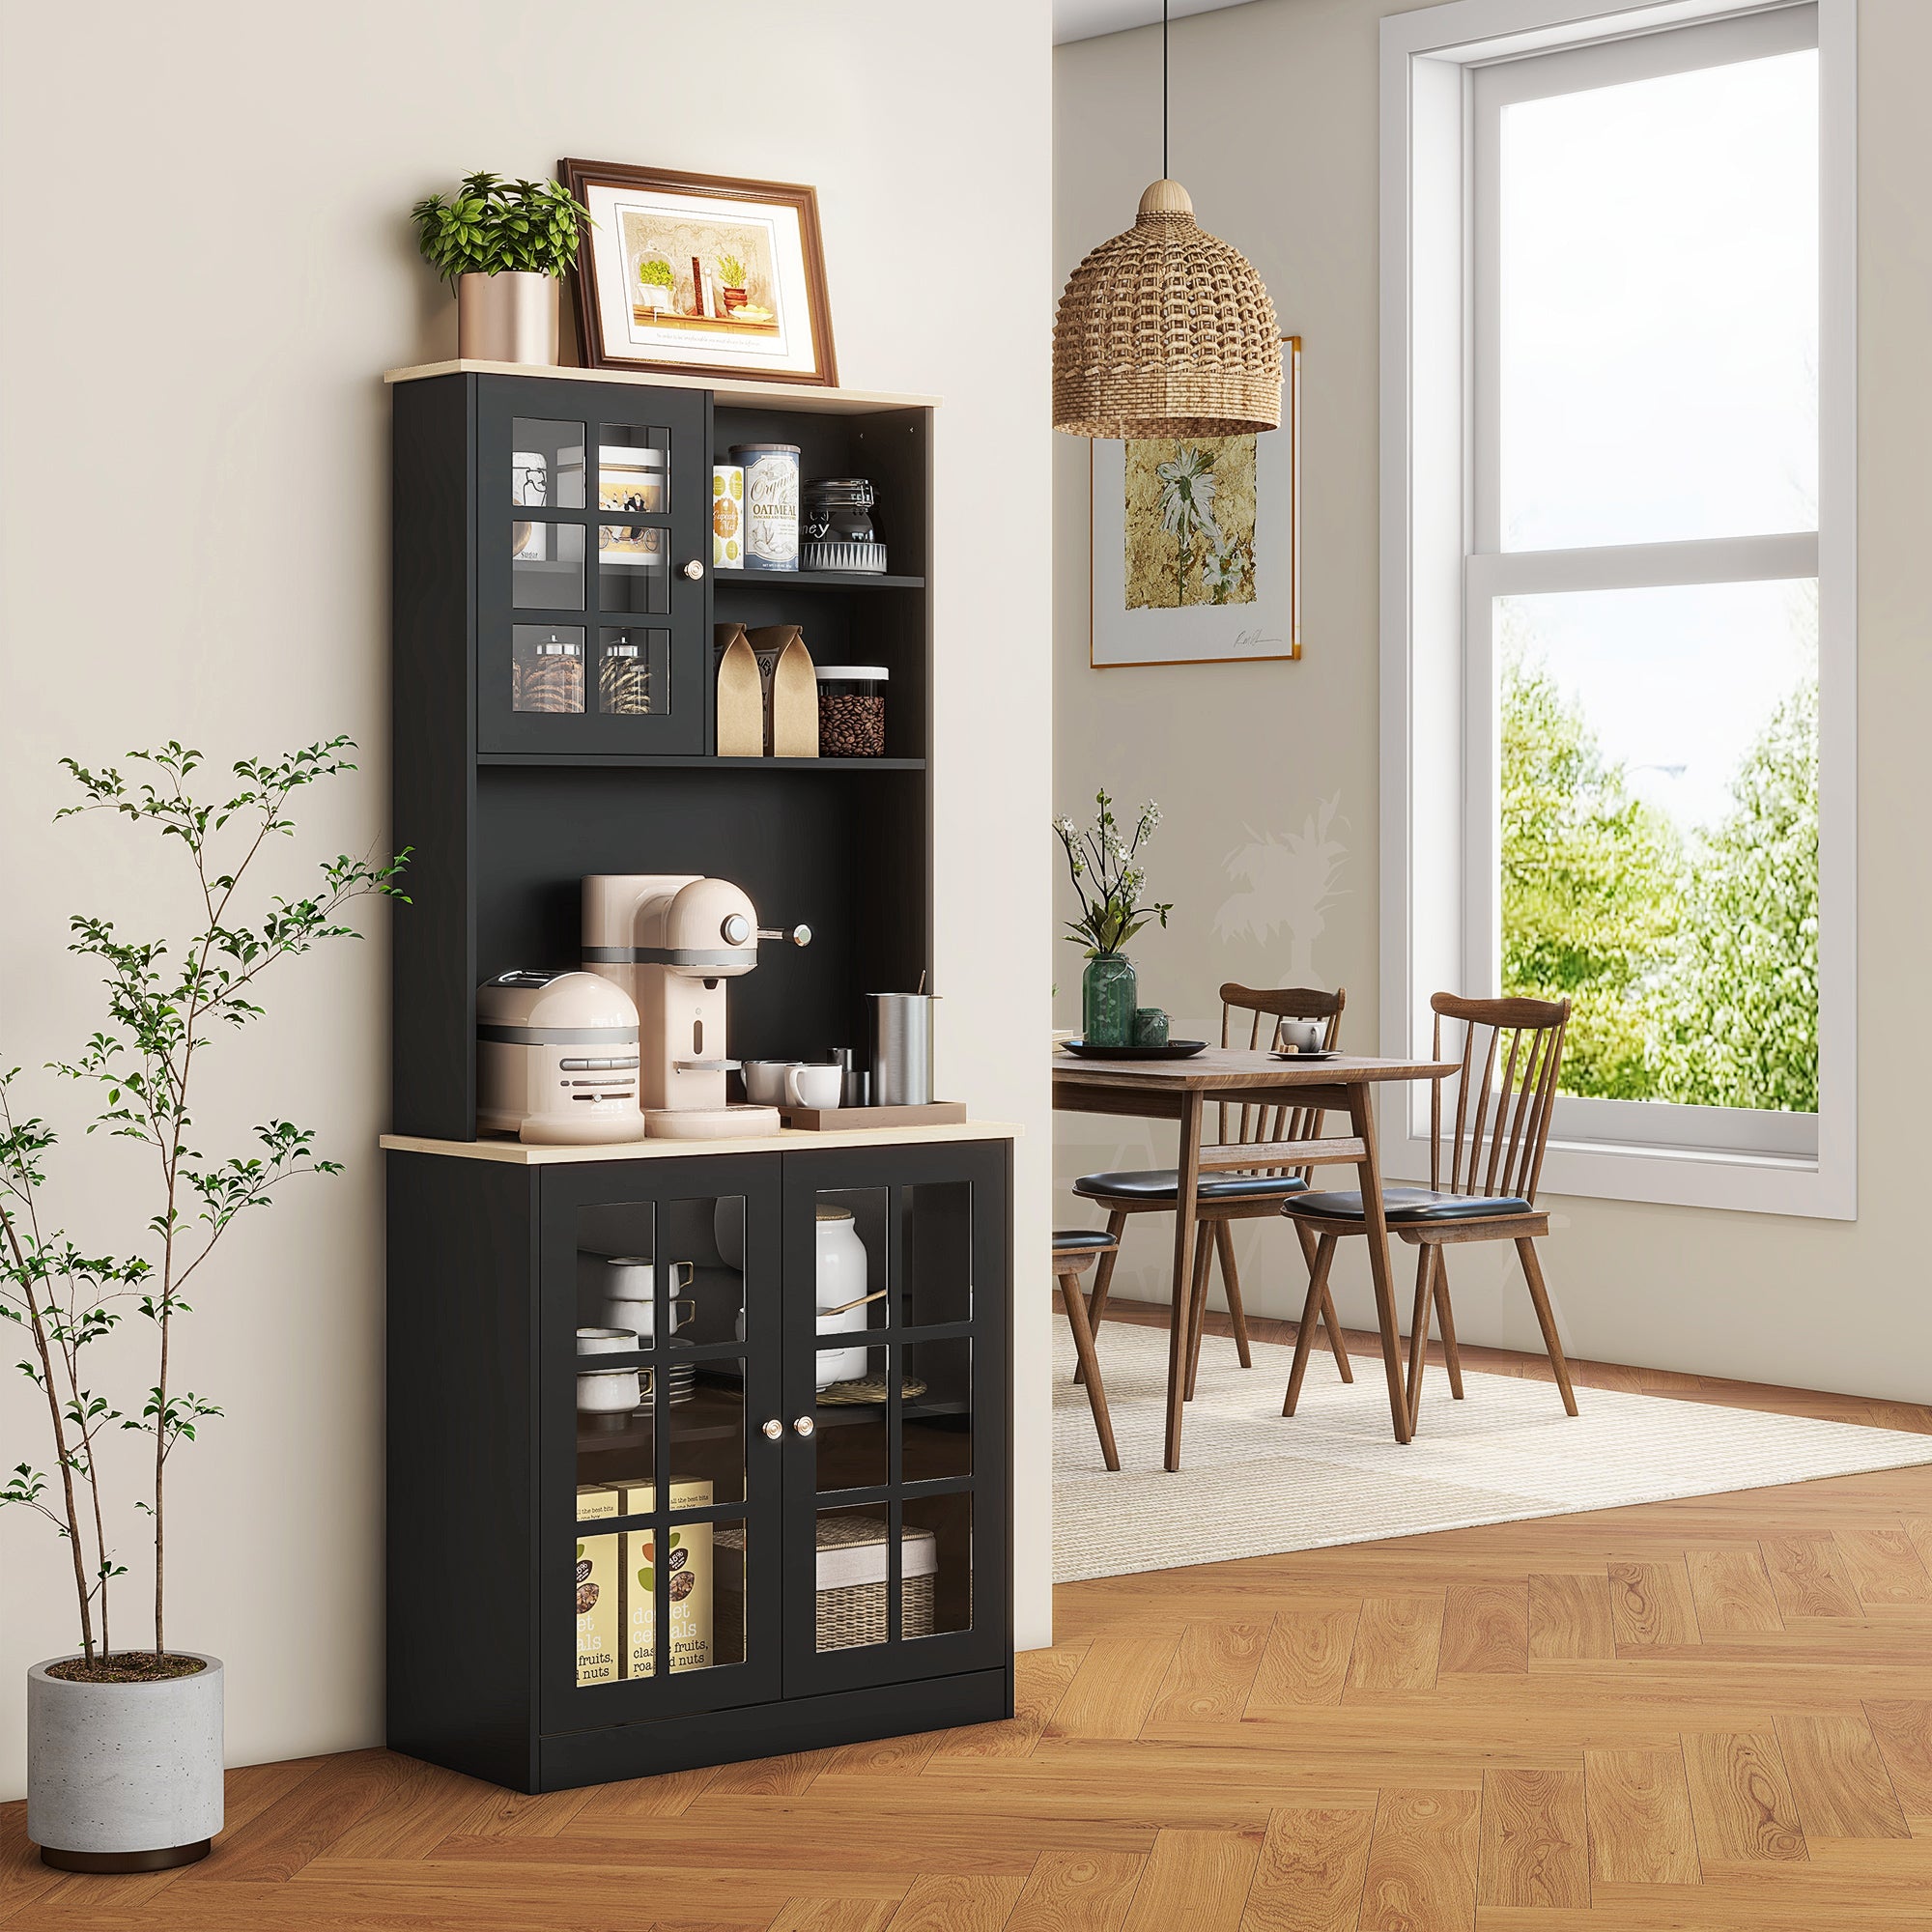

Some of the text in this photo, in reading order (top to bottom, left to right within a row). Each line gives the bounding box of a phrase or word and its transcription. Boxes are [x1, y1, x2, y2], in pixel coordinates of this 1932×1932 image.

[753, 504, 796, 516] OATMEAL
[802, 524, 830, 538] ney
[674, 1640, 708, 1653] fruits,
[578, 1653, 613, 1666] fruits,
[678, 1654, 704, 1666] nuts
[582, 1666, 610, 1679] nuts
